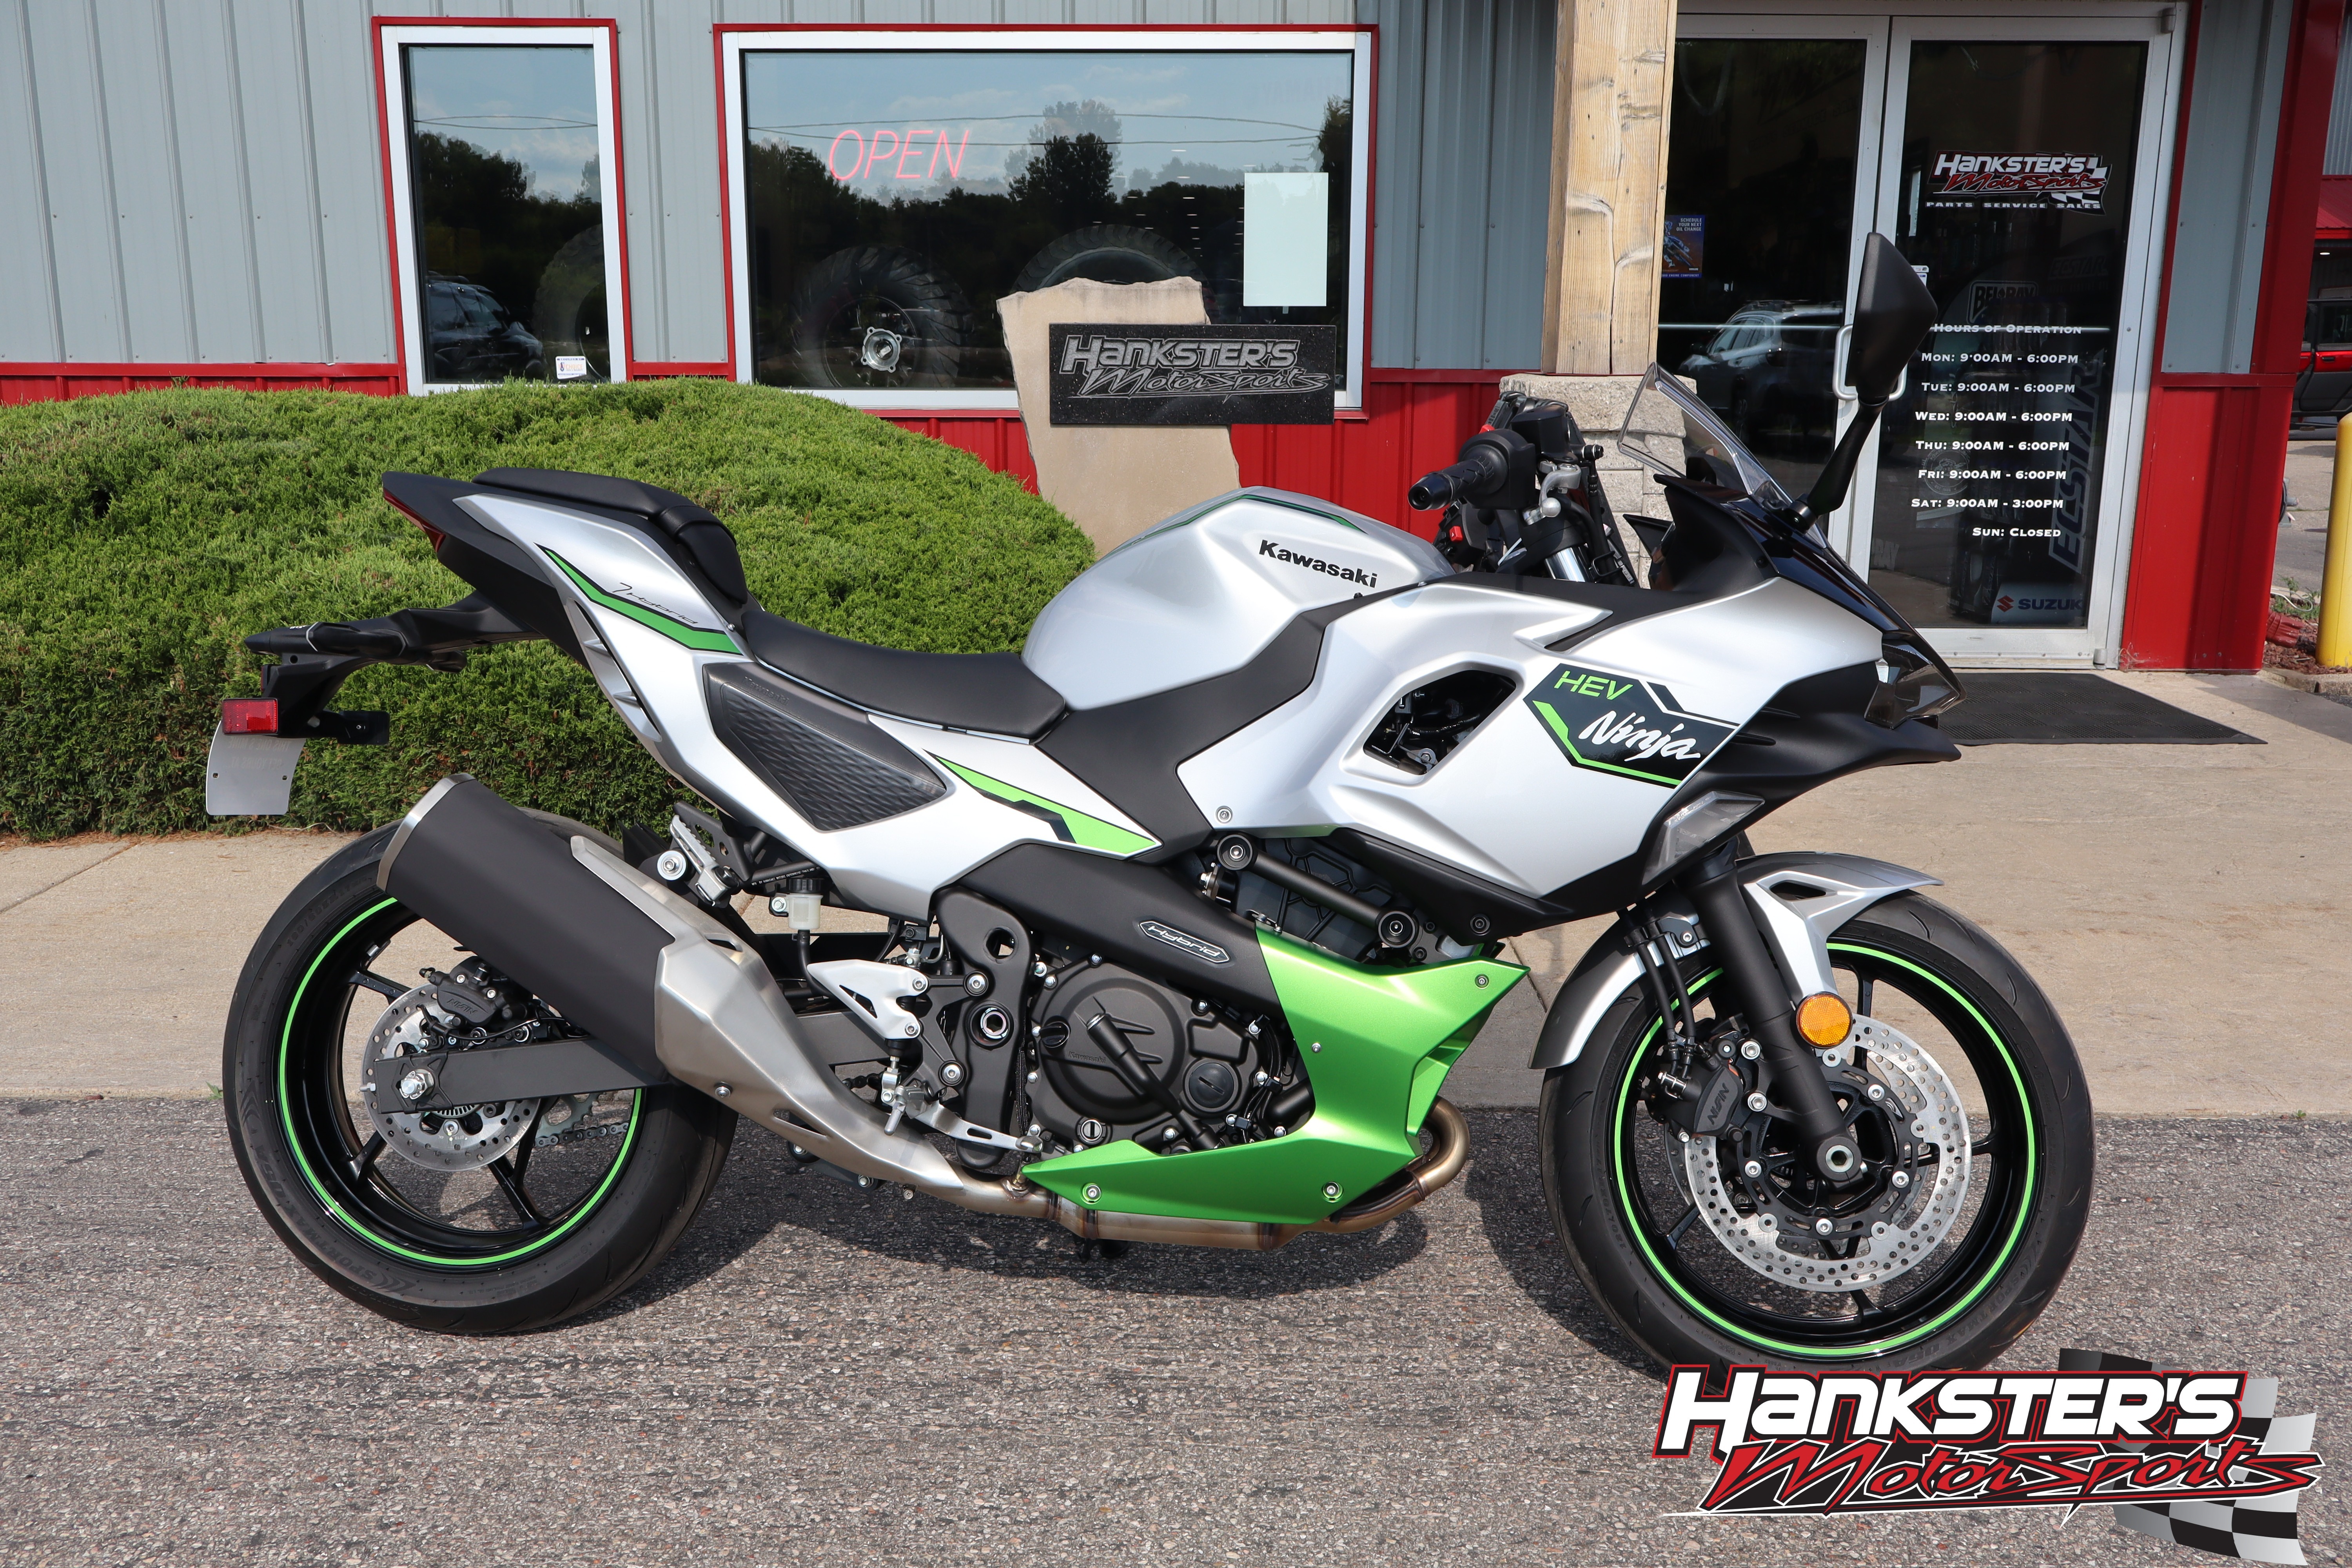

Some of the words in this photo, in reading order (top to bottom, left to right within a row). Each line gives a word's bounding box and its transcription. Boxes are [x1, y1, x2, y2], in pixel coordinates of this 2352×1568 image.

[828, 129, 970, 181] OPEN
[1934, 323, 1979, 332] HOURS
[1984, 325, 2001, 333] OF
[2006, 324, 2082, 334] OPERATION
[2027, 355, 2078, 363] 6:00PM
[1922, 383, 1951, 391] TUE:
[2024, 384, 2074, 392] 6:00PM
[1915, 412, 1949, 420] WED:
[1955, 412, 2006, 421] 9:00AM
[2022, 413, 2072, 421] 6:00PM
[1916, 441, 1947, 449] THU:
[1952, 441, 2004, 450] 9:00AM
[2019, 442, 2069, 450] 6:00PM
[1918, 470, 1944, 478] FRI:
[1949, 470, 2001, 479] 9:00AM
[2016, 471, 2066, 479] 6:00PM
[1911, 499, 1941, 507] SAT:
[1947, 499, 1998, 507] 9:00AM
[2013, 499, 2063, 508] 3:00PM
[1973, 528, 2004, 536] SUN:
[2010, 528, 2061, 537] CLOSED
[1259, 539, 1378, 588] Kawasaki
[2018, 598, 2082, 610] SUZUK
[743, 676, 789, 706] Kawasaki
[1554, 670, 1634, 700] HEV
[1578, 710, 1701, 762] Ninja
[1147, 924, 1223, 958] Hybrid
[1067, 1051, 1106, 1063] Kawasaki
[283, 1200, 377, 1284] SPORTMAX
[1944, 1274, 2021, 1346] SPORTMAX
